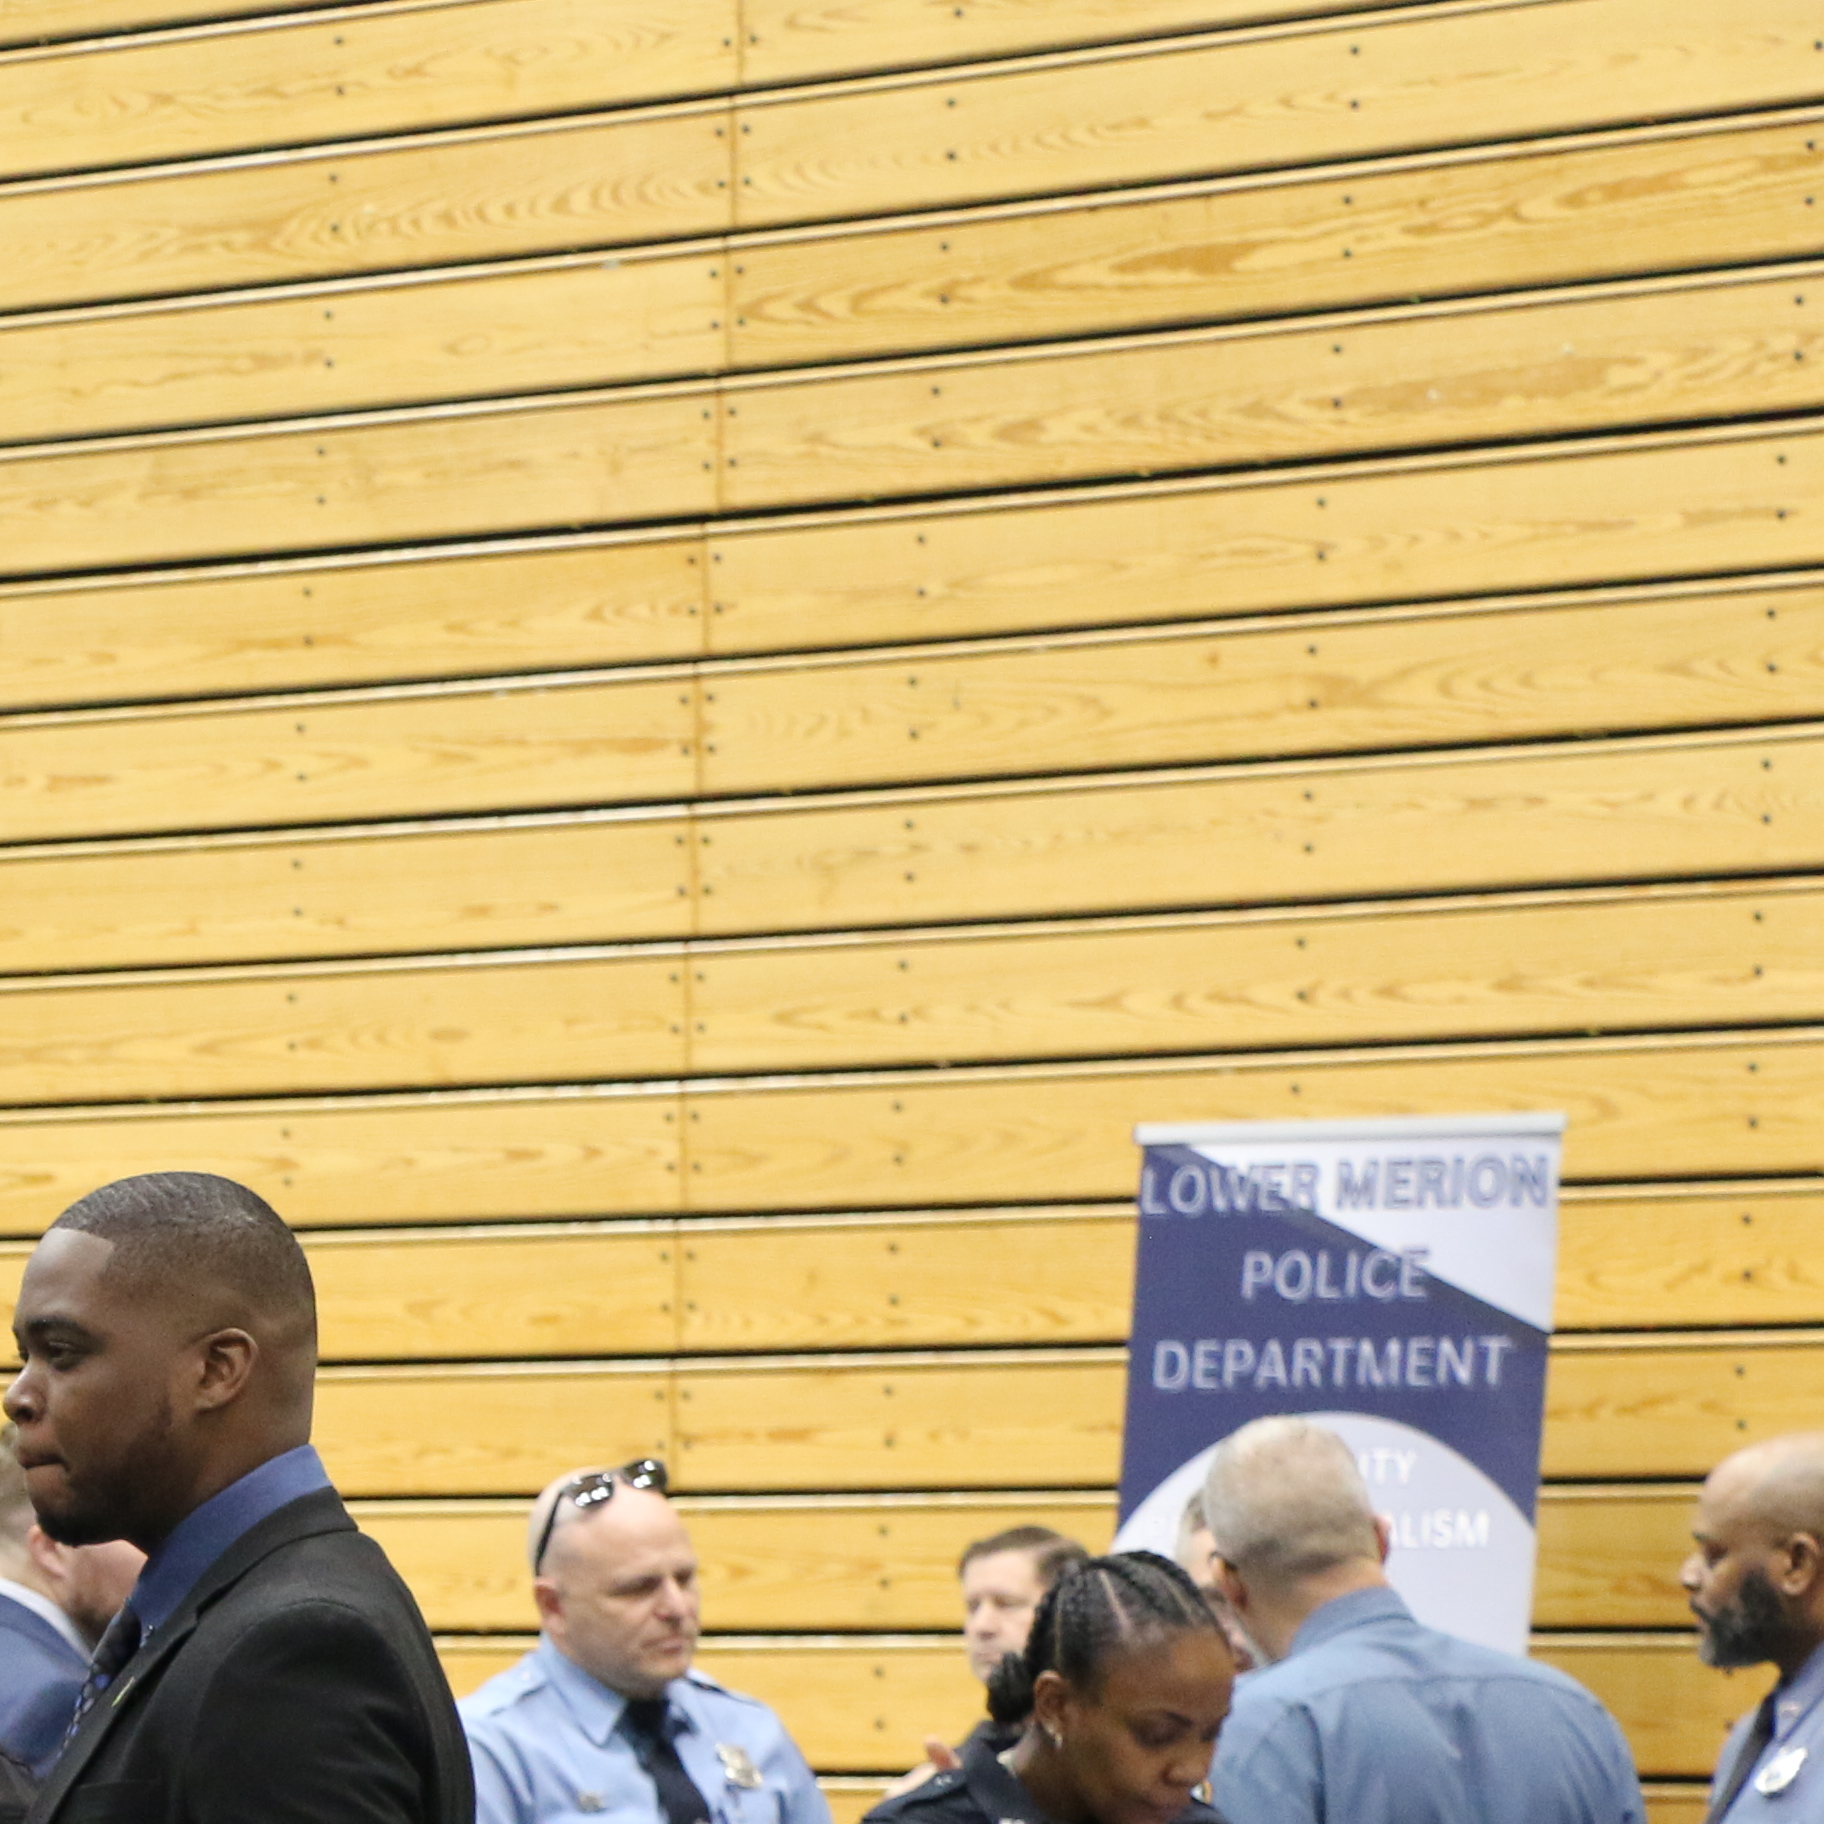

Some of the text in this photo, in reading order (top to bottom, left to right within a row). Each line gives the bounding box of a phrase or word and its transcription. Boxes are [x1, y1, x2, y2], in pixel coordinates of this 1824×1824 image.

[1139, 1154, 1550, 1216] LOWER MERION
[1240, 1244, 1431, 1302] POLICE
[1153, 1334, 1514, 1392] DEPARTMENT
